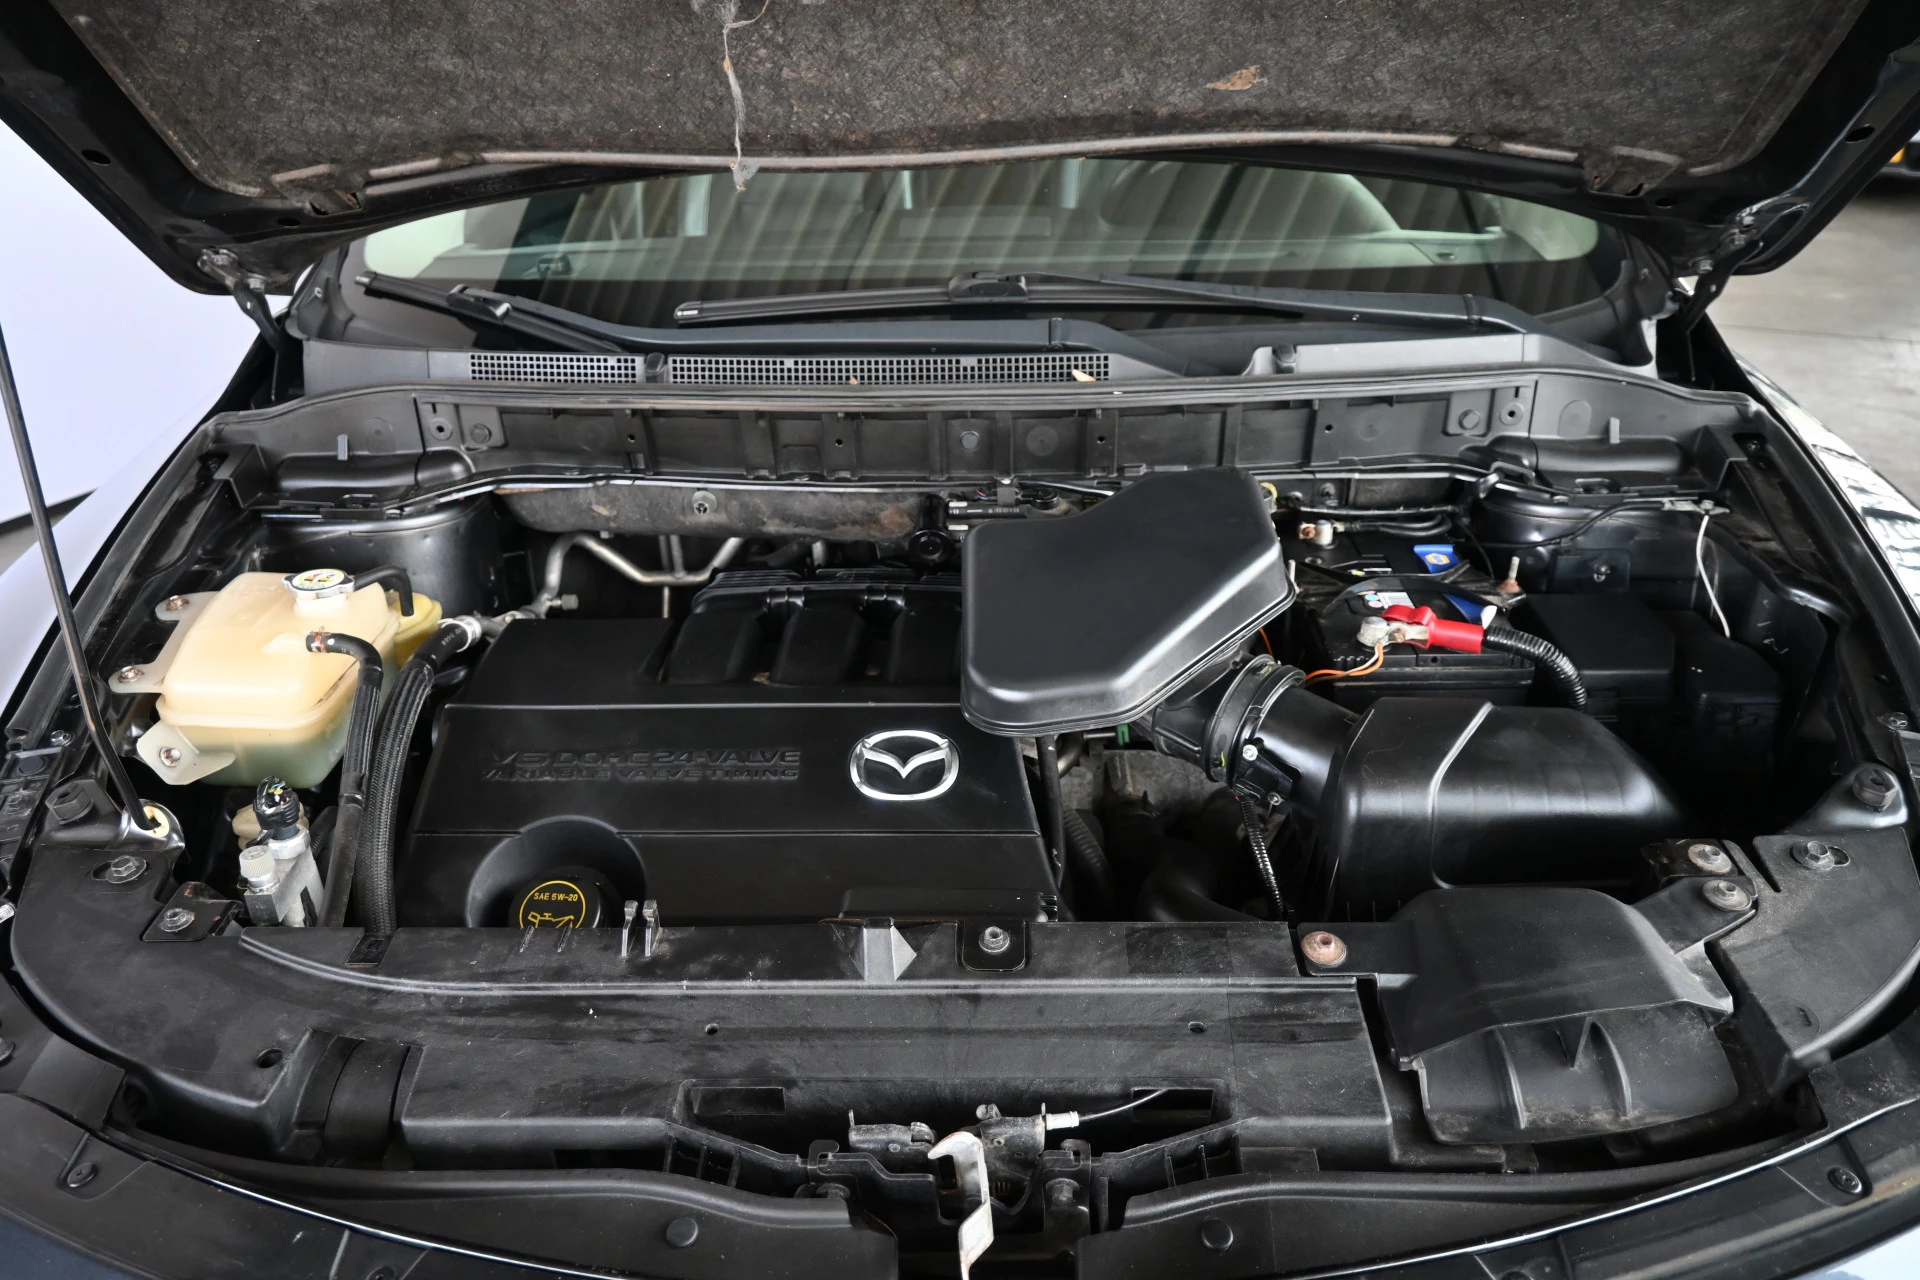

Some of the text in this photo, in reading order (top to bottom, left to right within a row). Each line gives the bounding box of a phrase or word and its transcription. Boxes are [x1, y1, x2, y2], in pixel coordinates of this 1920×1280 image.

[652, 749, 801, 766] 24-VALVE
[614, 768, 702, 782] VALVE
[704, 768, 799, 782] TIMING
[533, 892, 579, 902] SAE 5W-20
